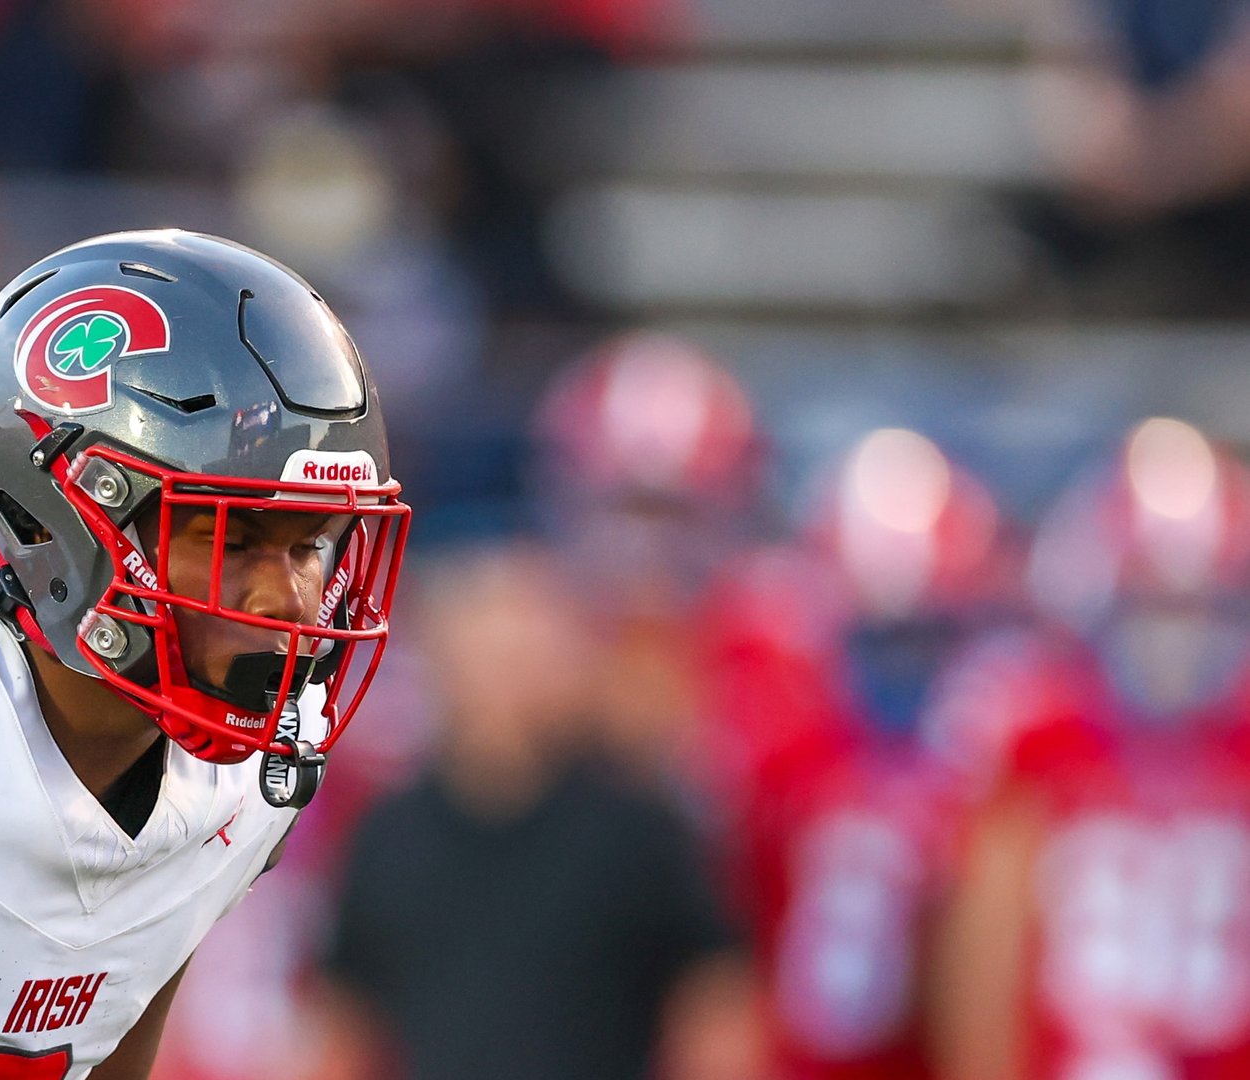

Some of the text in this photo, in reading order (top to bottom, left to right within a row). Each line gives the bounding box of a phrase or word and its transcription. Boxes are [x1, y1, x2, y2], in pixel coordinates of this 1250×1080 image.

[303, 461, 372, 481] Riddell
[316, 566, 348, 627] iddell
[225, 712, 267, 729] Riddell
[2, 972, 108, 1033] IRISH
